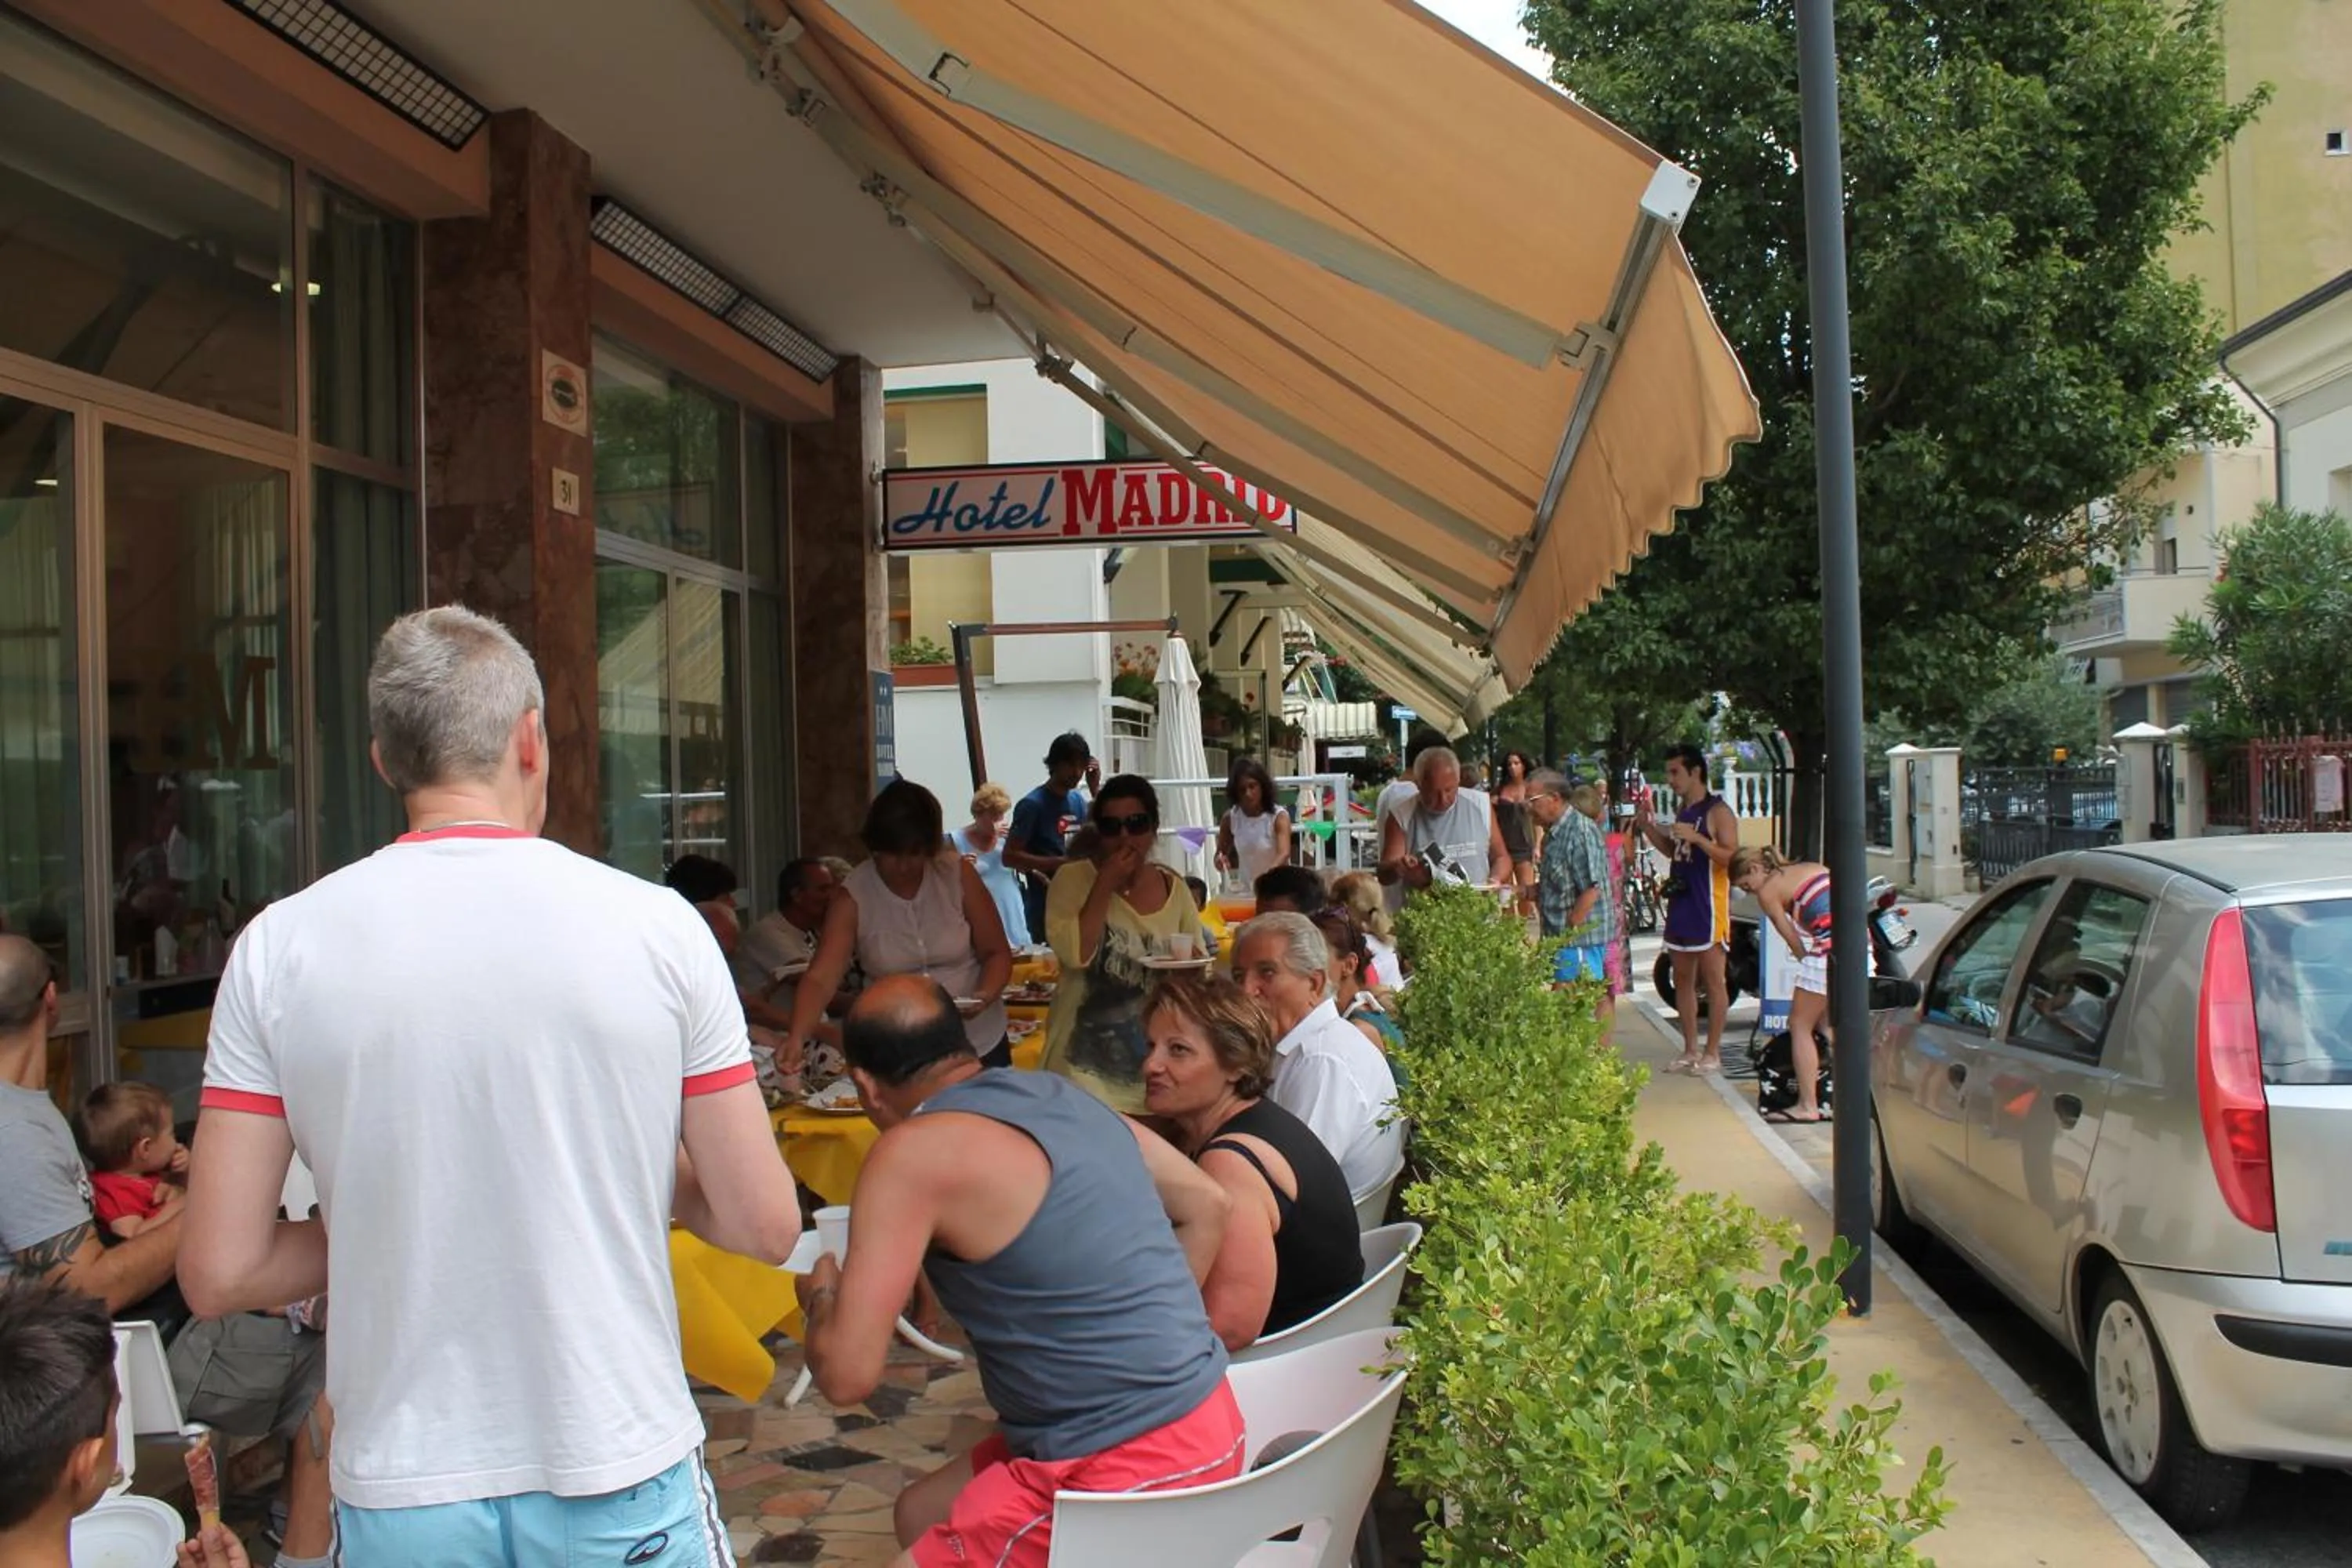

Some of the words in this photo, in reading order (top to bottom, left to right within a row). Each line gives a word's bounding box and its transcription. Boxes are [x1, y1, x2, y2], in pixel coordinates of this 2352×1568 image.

[560, 479, 572, 506] 31
[893, 476, 1054, 534] Hotel
[1764, 1014, 1790, 1030] HOT
